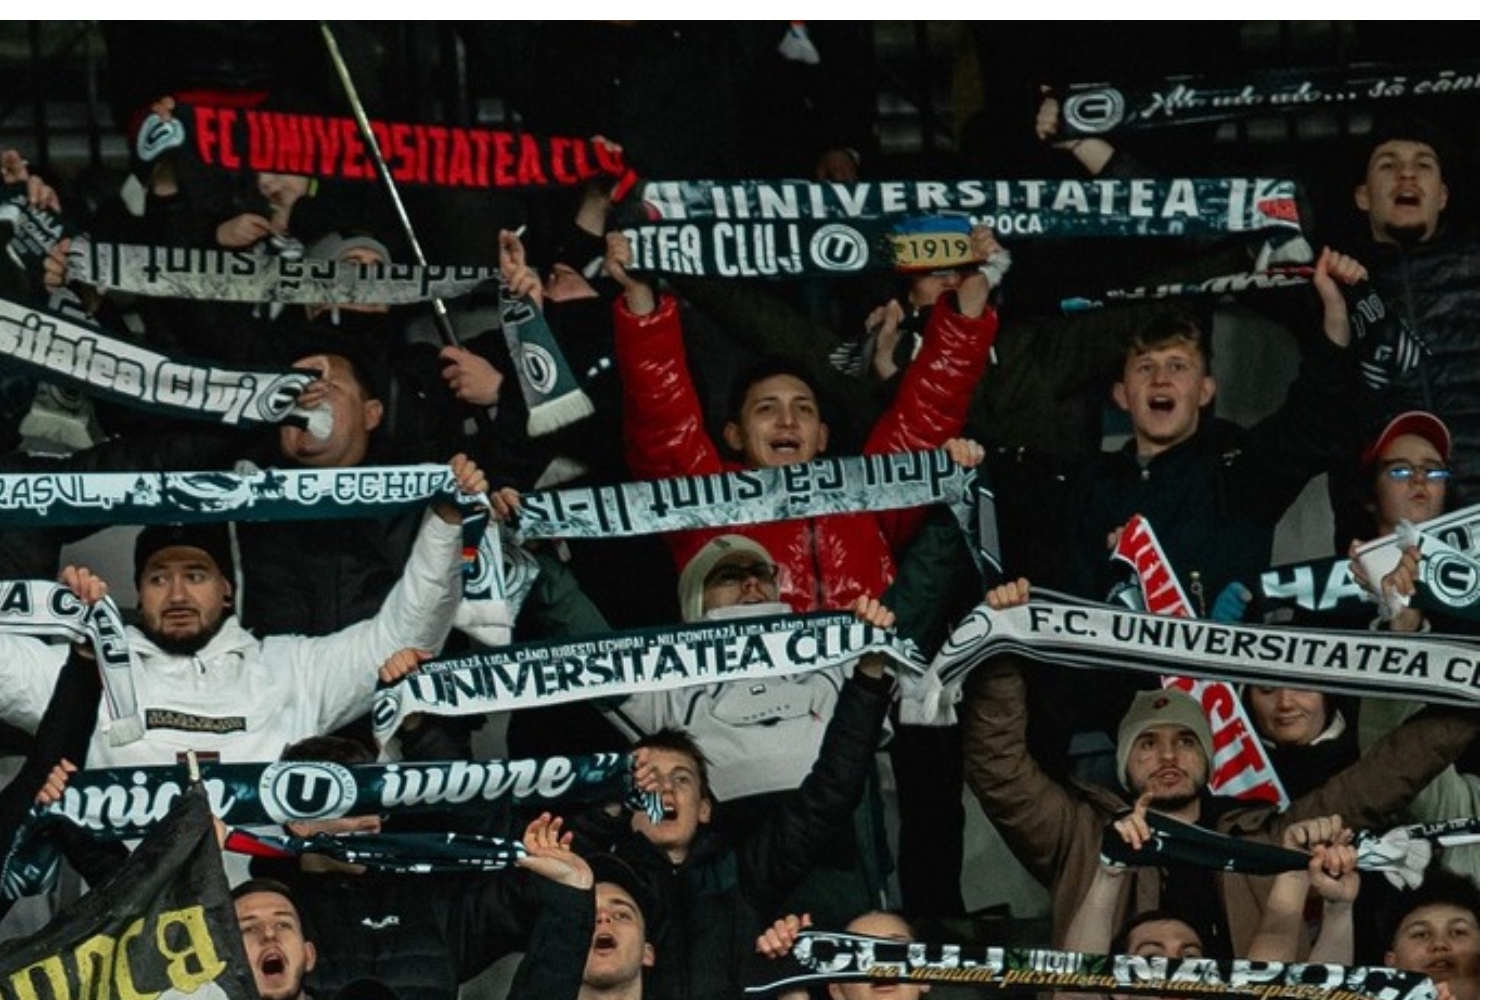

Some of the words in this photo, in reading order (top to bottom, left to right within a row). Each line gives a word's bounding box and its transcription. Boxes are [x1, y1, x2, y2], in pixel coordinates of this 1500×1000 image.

[194, 107, 241, 169] FC
[246, 112, 547, 187] UNIVERSITATEA
[713, 222, 804, 277] CLUJ
[910, 238, 970, 260] 1919
[408, 634, 776, 708] UNIVERSITATEA
[1029, 606, 1097, 638] F.C.
[1113, 614, 1428, 677] UNIVERSITATEA
[381, 755, 577, 806] iubire
